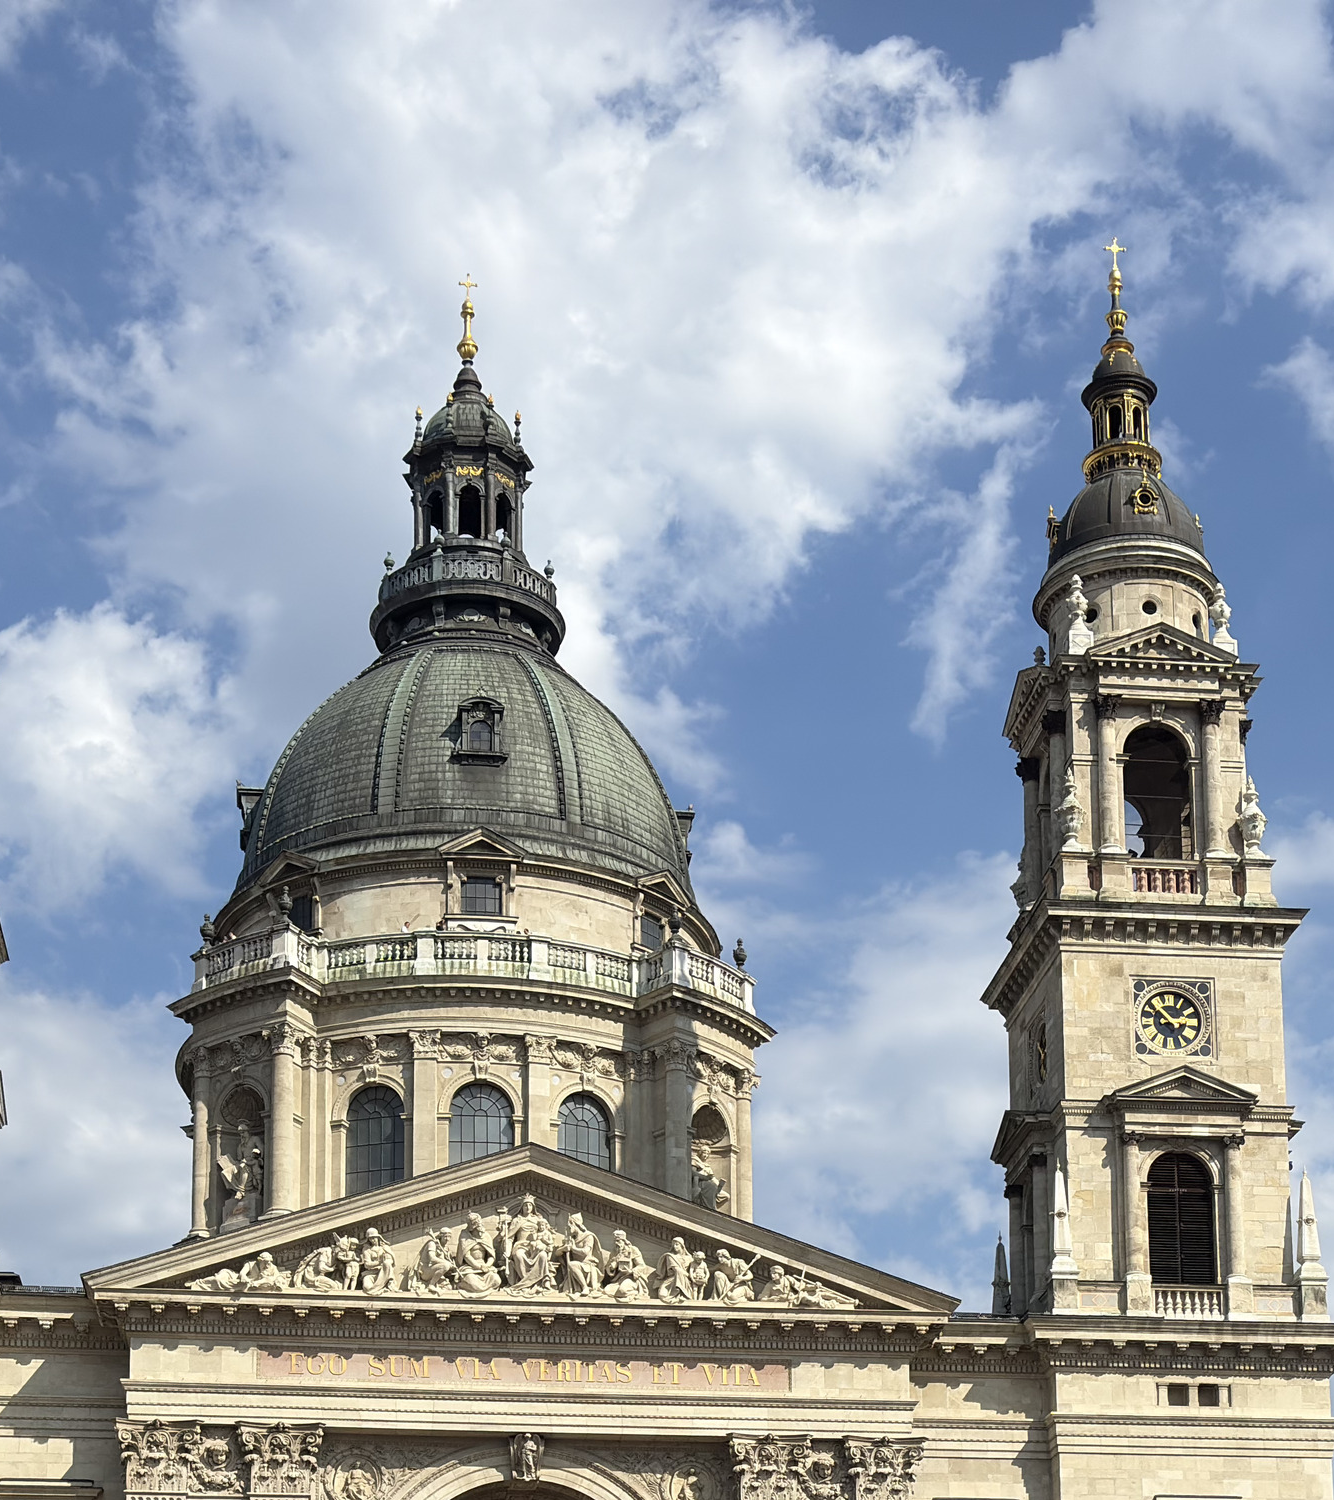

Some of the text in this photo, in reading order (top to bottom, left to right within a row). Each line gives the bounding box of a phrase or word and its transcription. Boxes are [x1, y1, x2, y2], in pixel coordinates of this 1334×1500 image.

[288, 1353, 761, 1386] EGO SUM VIA VERITAS ET VITA
